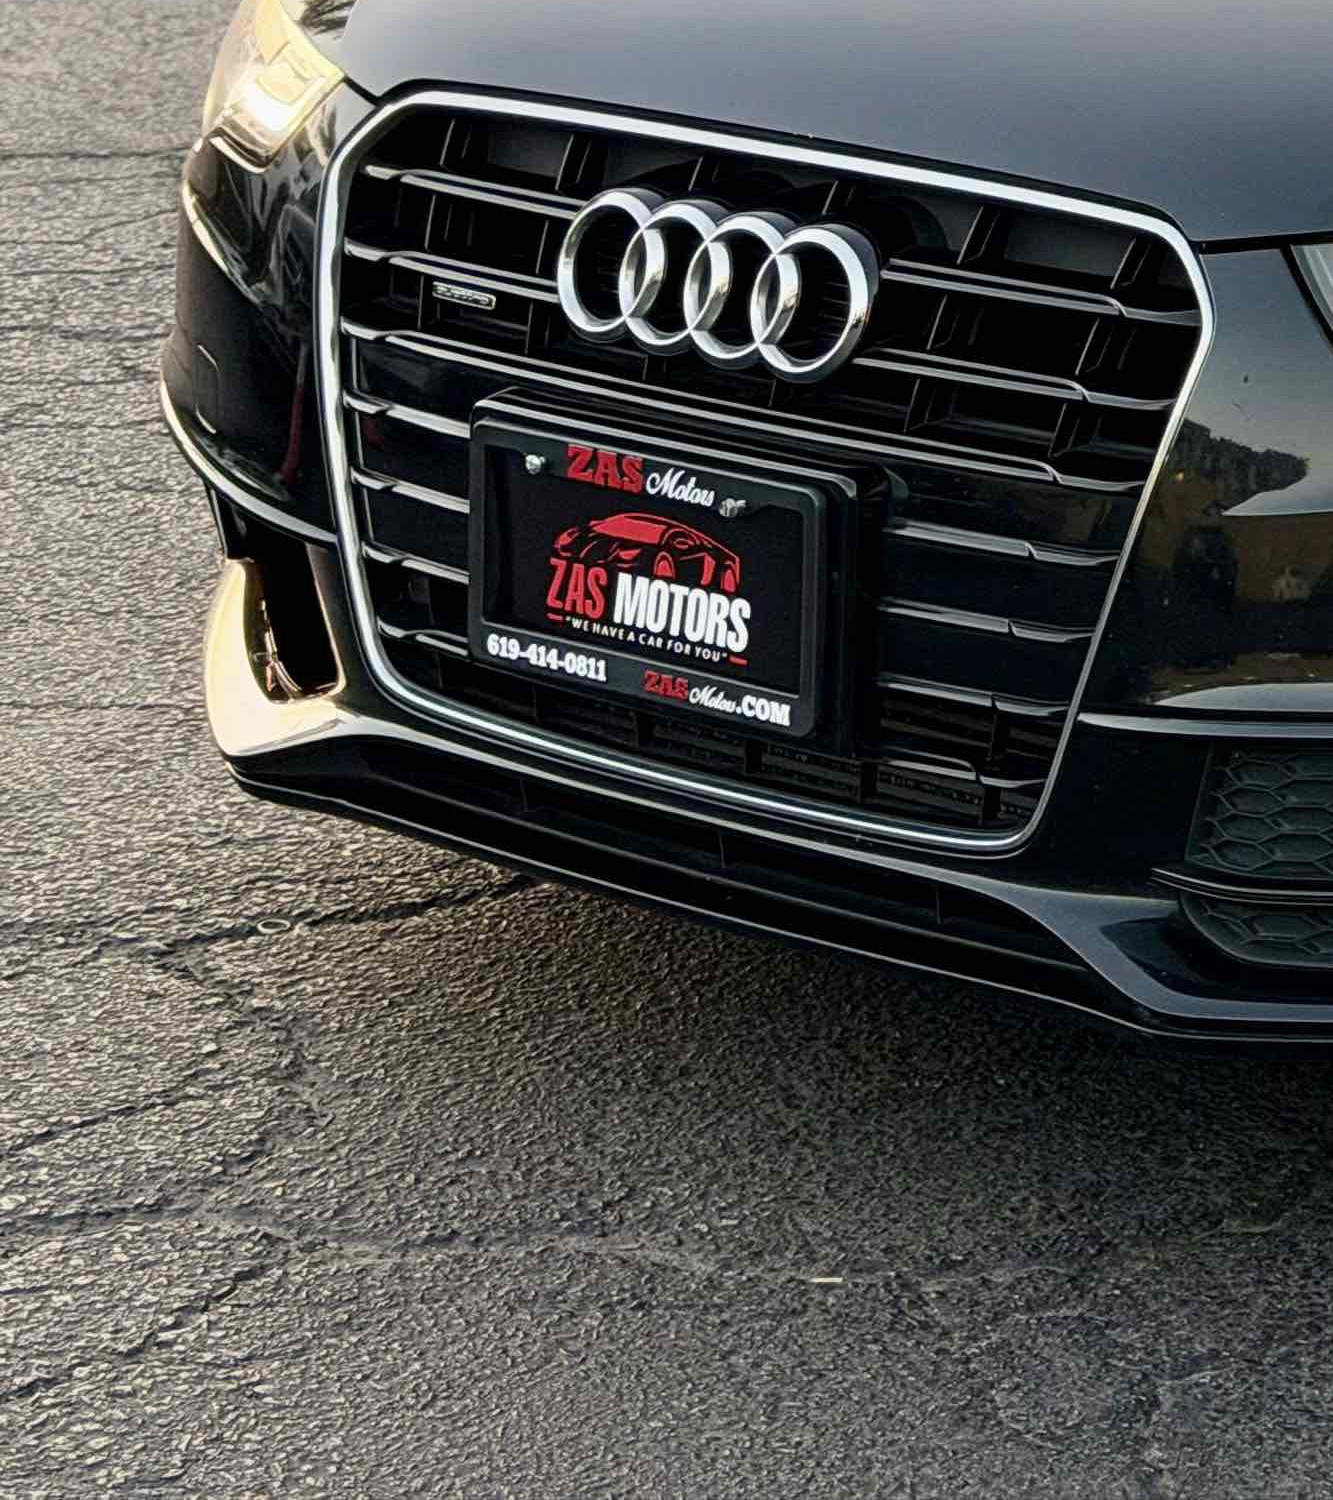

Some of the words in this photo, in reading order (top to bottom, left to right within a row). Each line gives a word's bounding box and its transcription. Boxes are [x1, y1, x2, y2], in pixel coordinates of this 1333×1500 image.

[567, 443, 643, 493] ZAS
[646, 467, 715, 507] Motors
[547, 558, 608, 619] ZAS
[613, 572, 751, 653] MOTORS
[486, 633, 608, 683] 619-414-0811
[592, 621, 625, 641] HAVE
[626, 631, 635, 643] A
[638, 633, 663, 649] CAR
[666, 639, 691, 656] FOR
[644, 670, 689, 700] ZAS
